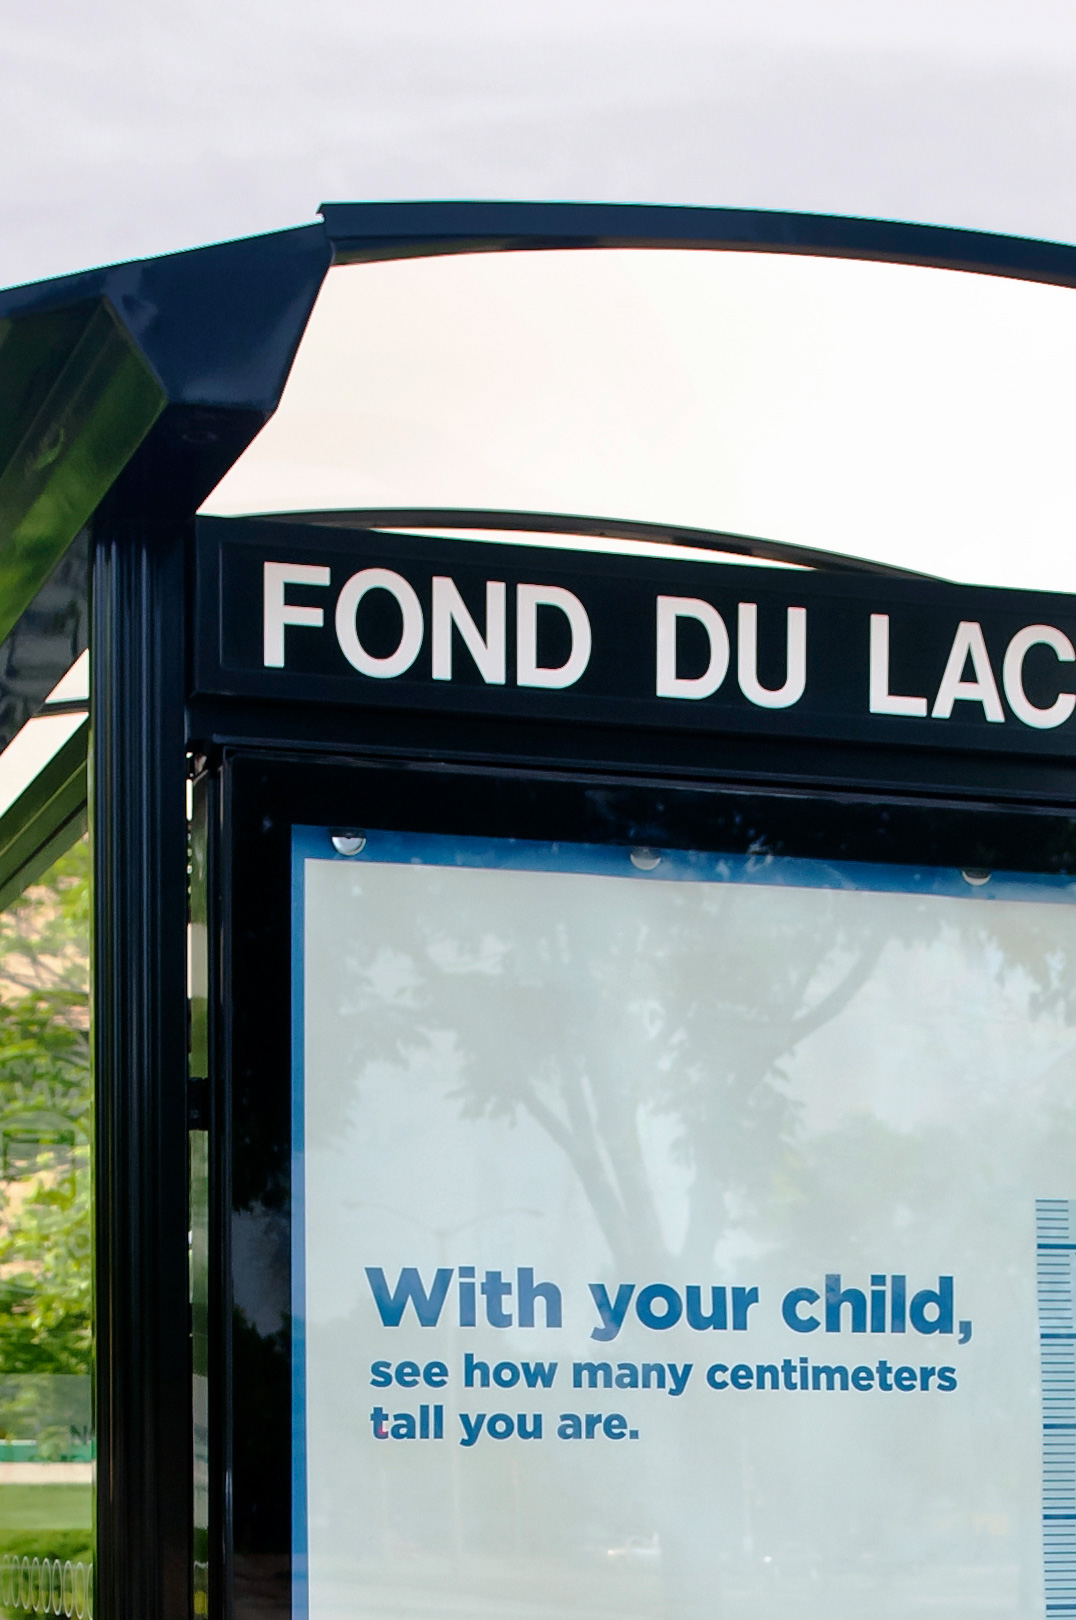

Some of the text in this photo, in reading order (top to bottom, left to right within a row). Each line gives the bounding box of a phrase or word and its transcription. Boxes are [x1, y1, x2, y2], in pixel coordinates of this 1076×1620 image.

[264, 562, 591, 688] FOND
[657, 596, 806, 708] DU
[870, 614, 1076, 728] LAC
[365, 1267, 971, 1343] With your child,
[371, 1354, 957, 1395] see how many centimeters
[371, 1405, 638, 1446] tall you are.
